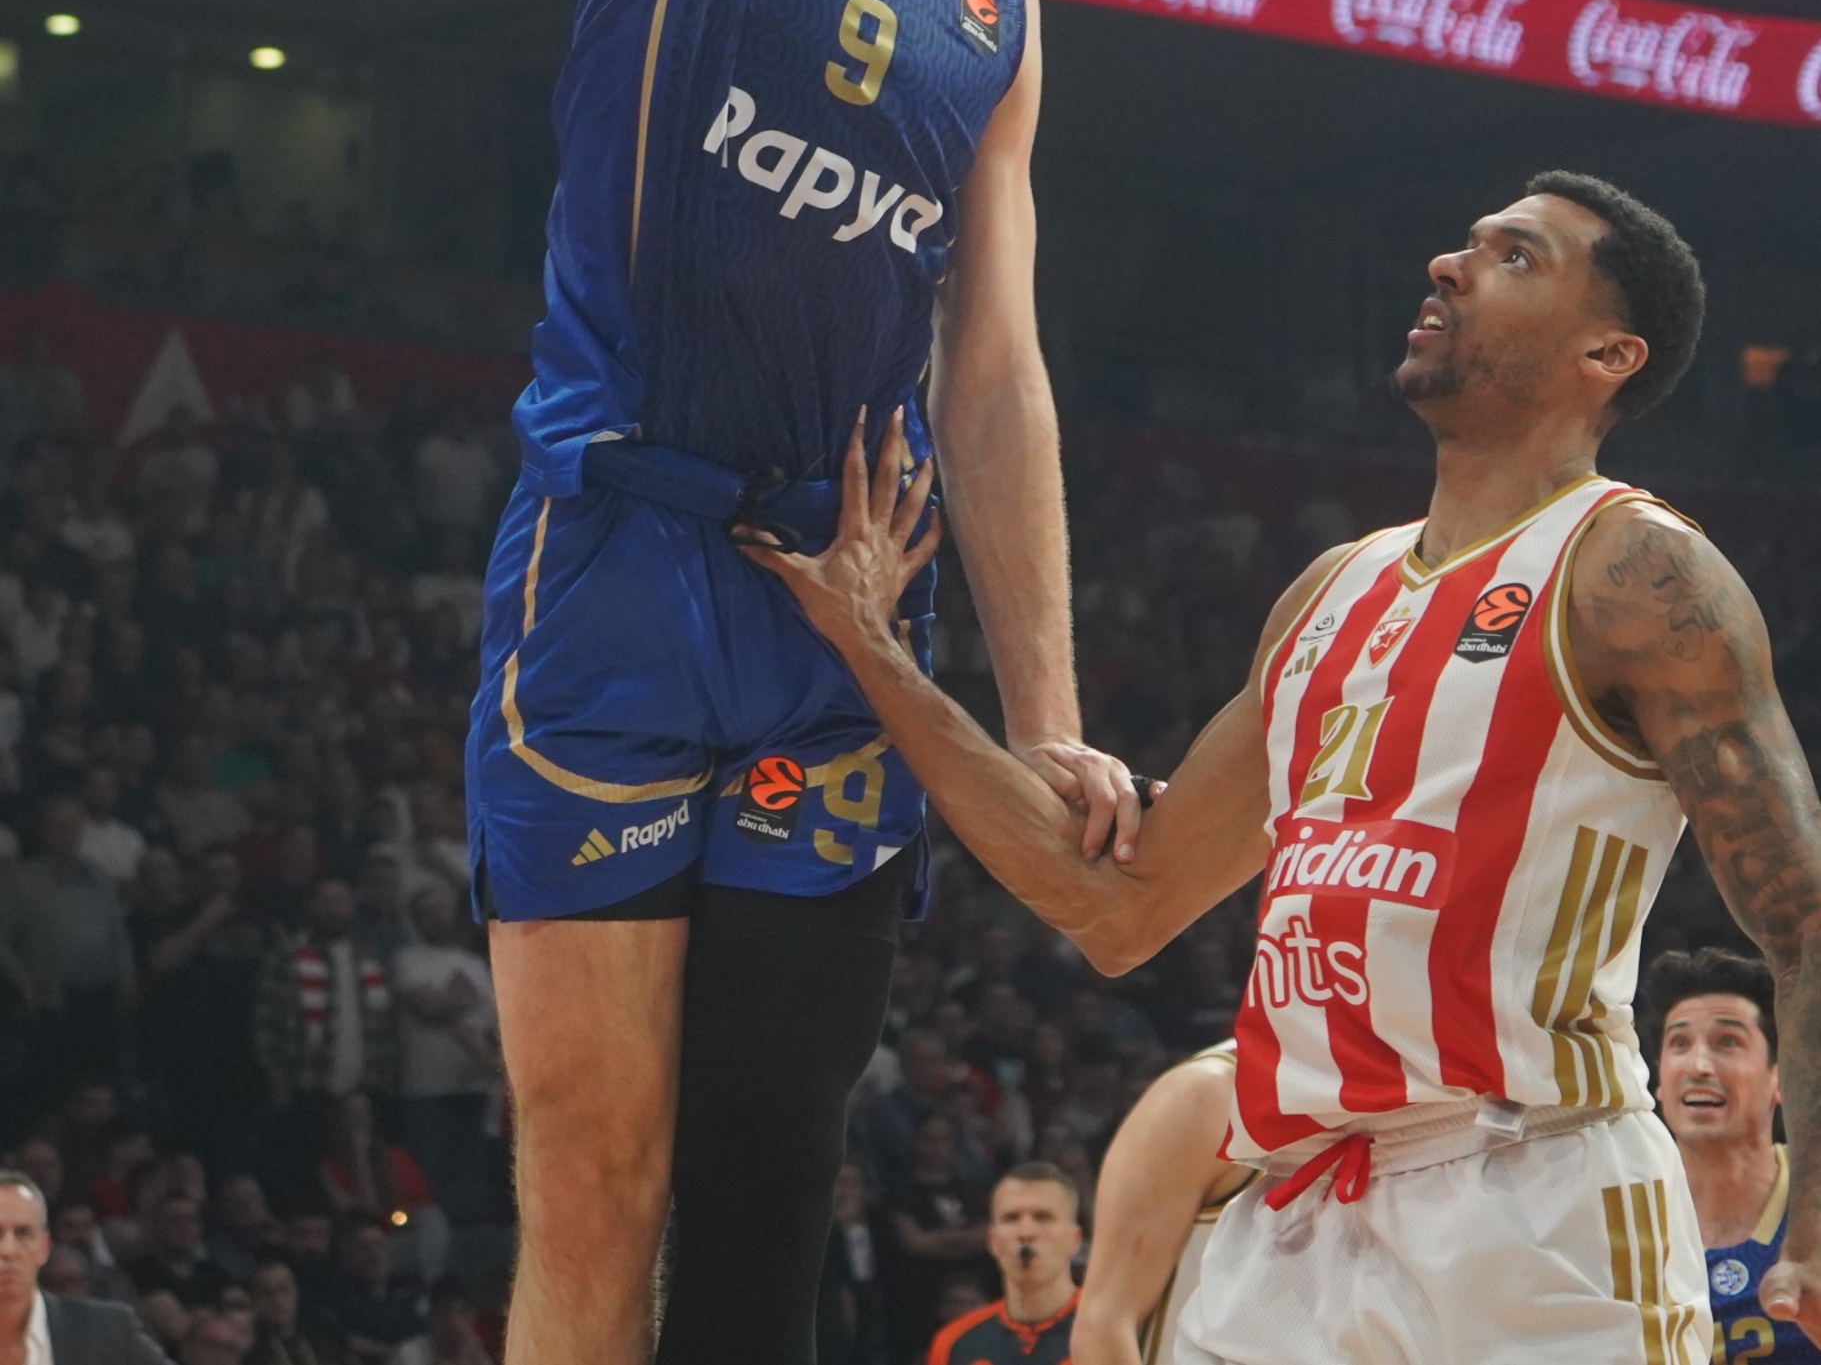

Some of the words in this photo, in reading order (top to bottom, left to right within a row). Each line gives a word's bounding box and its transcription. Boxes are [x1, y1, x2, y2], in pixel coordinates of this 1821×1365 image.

[1299, 696, 1396, 808] 21
[620, 799, 691, 854] Rapyd
[737, 818, 757, 830] abu
[757, 823, 790, 839] dhabi
[813, 753, 885, 865] 9
